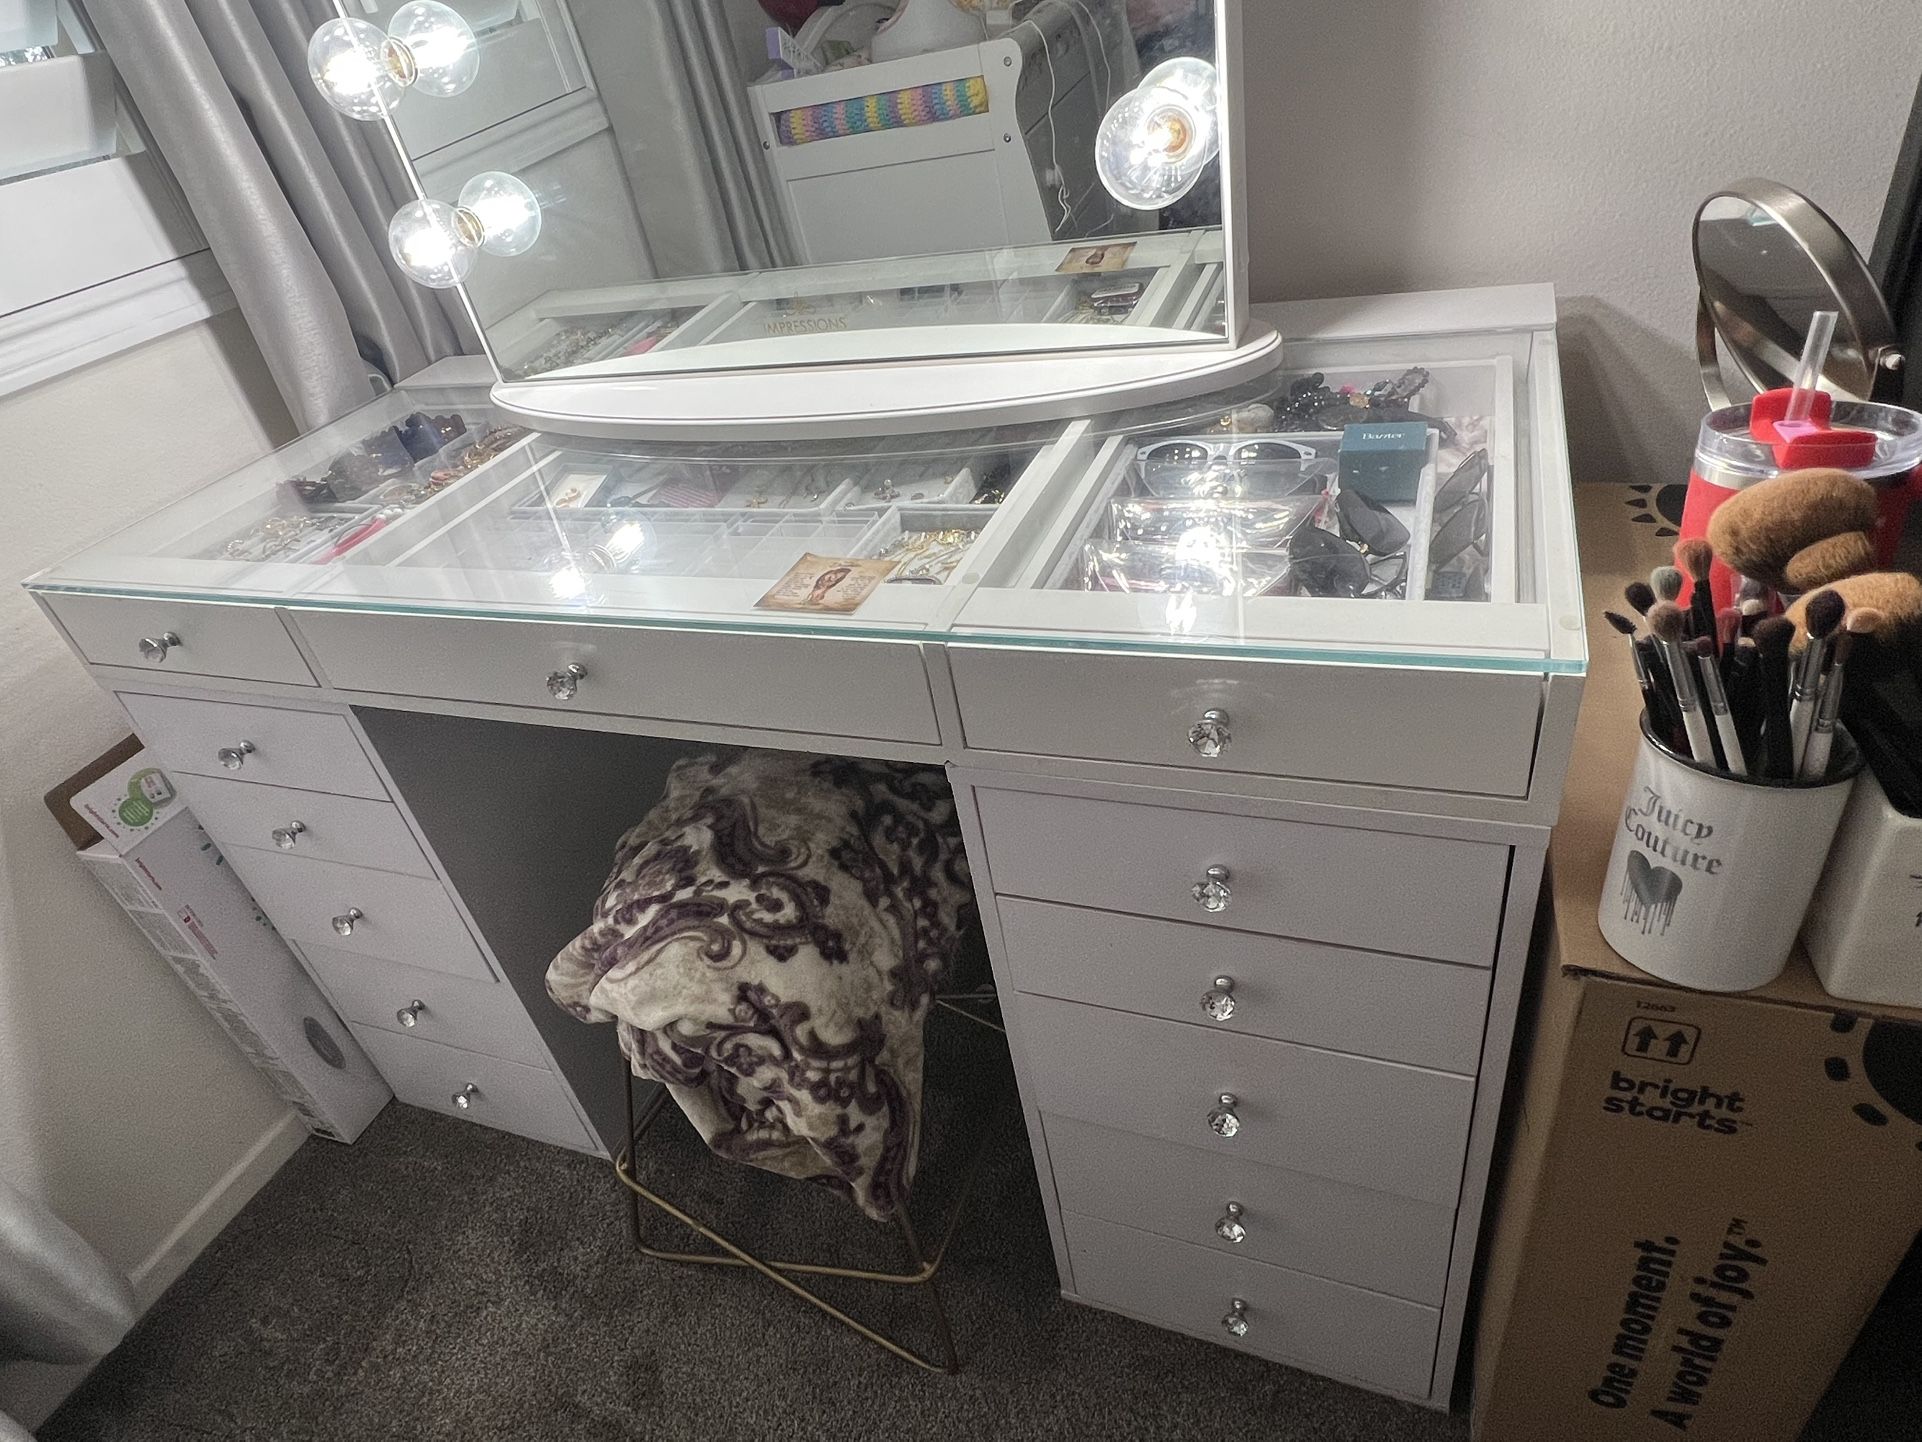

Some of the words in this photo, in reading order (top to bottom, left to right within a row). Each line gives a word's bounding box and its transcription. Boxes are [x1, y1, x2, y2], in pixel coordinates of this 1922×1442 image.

[763, 317, 848, 336] IMPRESSIONS
[1638, 786, 1713, 845] Juicy
[1625, 806, 1722, 874] Couture
[1611, 1070, 1745, 1113] bright
[1612, 1236, 1680, 1361] moment.
[1689, 1291, 1737, 1329] of
[1588, 1362, 1638, 1410] One
[1667, 1327, 1724, 1405] world
[1650, 1409, 1694, 1431] A
